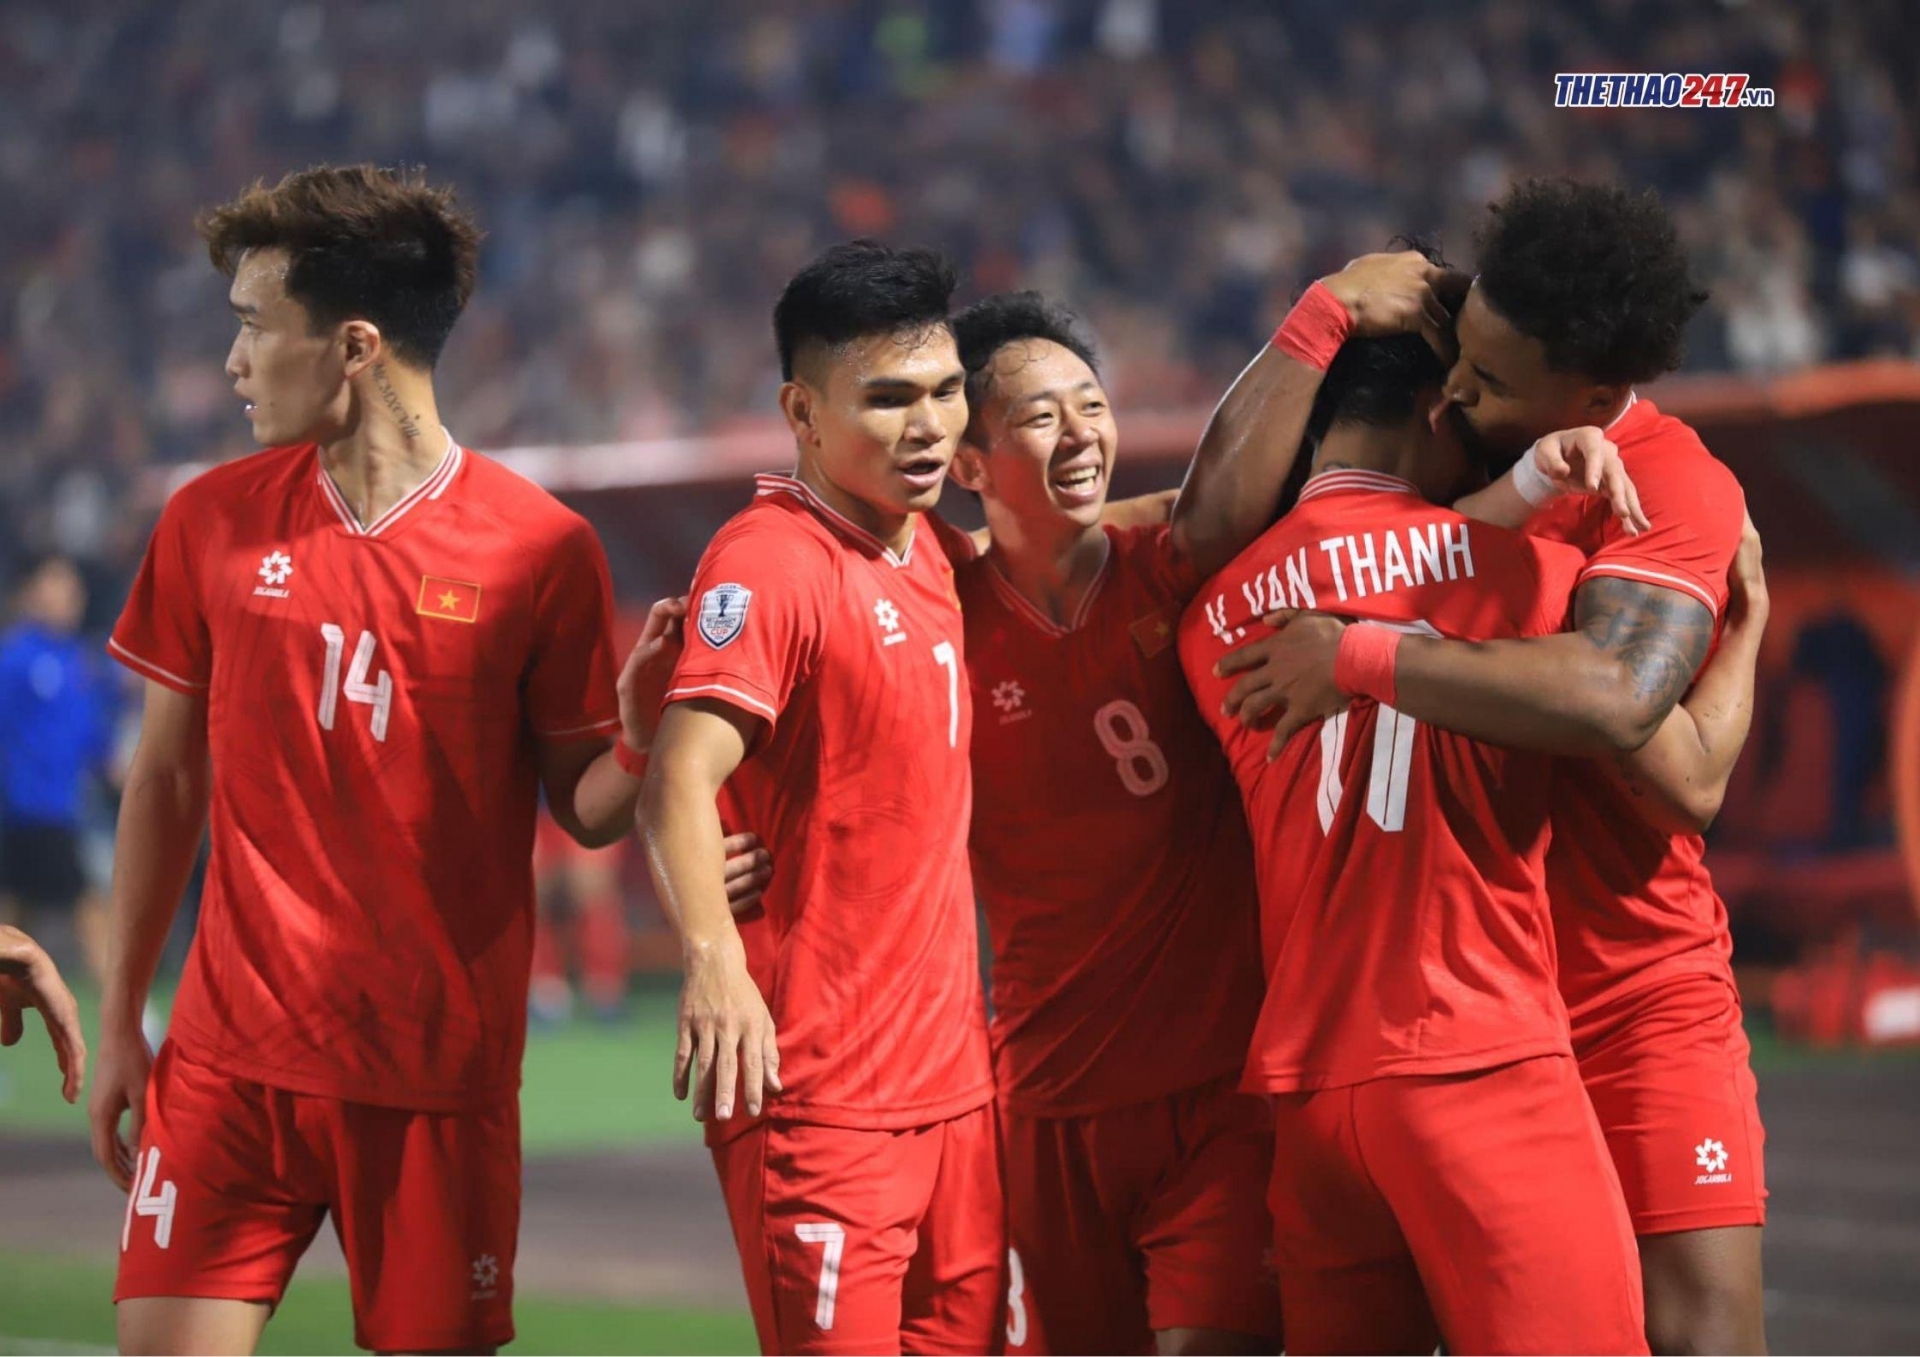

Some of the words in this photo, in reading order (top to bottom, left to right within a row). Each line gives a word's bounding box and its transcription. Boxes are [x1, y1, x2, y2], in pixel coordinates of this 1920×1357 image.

[710, 628, 729, 636] CUP
[1205, 594, 1246, 645] V.
[1242, 547, 1316, 616] VAN
[1320, 523, 1475, 602] THANH
[317, 622, 393, 742] 14
[932, 640, 959, 748] 7
[1093, 699, 1170, 797] 8
[122, 1145, 178, 1252] 14
[794, 1222, 846, 1330] 7
